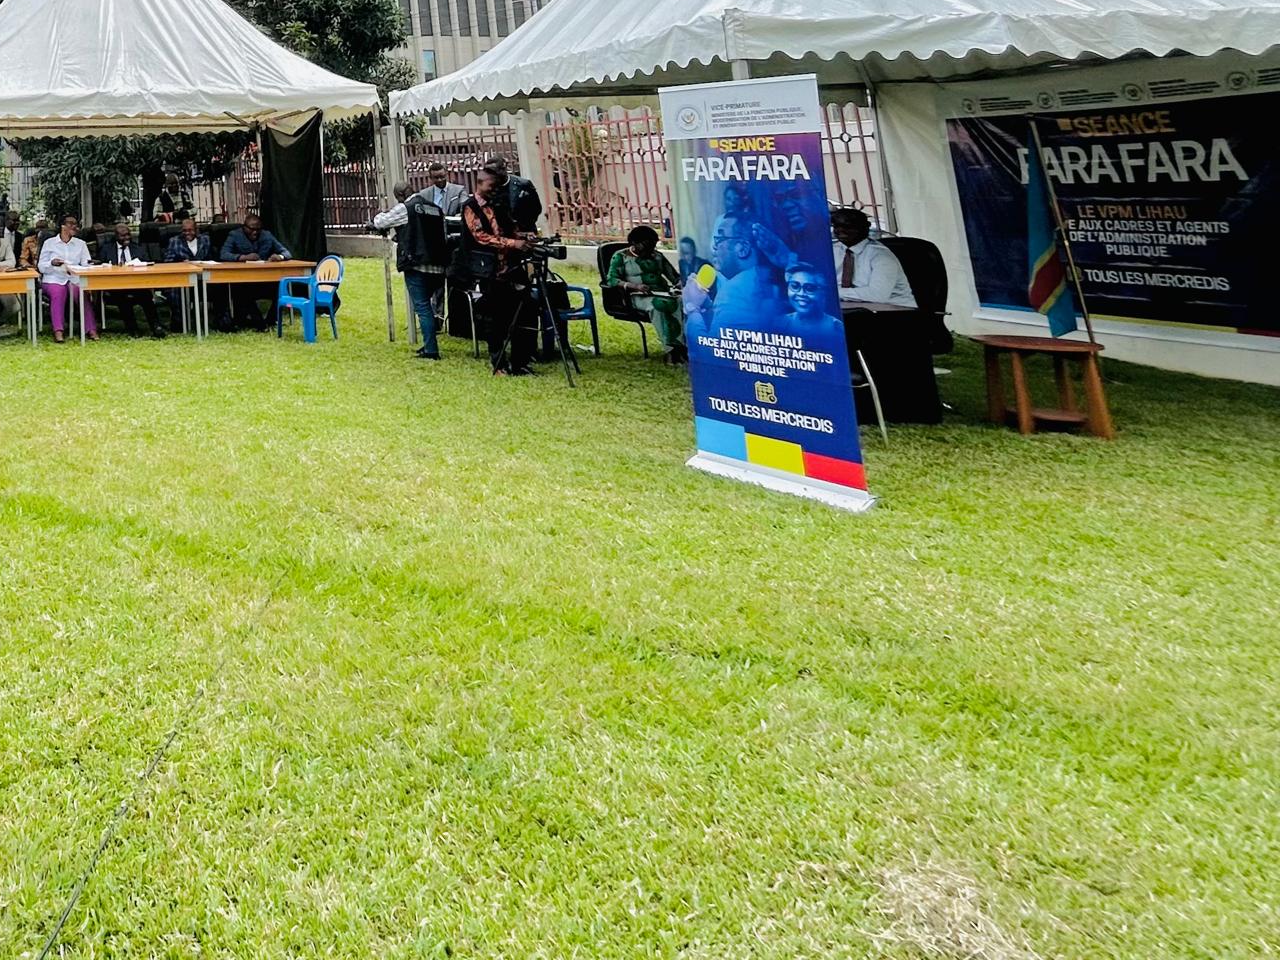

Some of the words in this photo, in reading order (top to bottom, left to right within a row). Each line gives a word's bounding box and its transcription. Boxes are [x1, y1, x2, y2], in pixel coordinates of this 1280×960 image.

[711, 101, 761, 110] VICE-PRIMATURE
[1073, 110, 1176, 137] SEANCE
[719, 136, 776, 153] SEANCE
[681, 156, 742, 181] FARA
[742, 154, 811, 181] FARA
[1118, 138, 1250, 183] FARA
[1077, 205, 1095, 218] LE
[1097, 205, 1133, 218] VPM
[1136, 205, 1187, 219] LIHAU
[1078, 219, 1103, 231] AUX
[1105, 219, 1155, 232] CADRES
[1157, 221, 1172, 232] ET
[1176, 221, 1230, 234] AGENTS
[1070, 231, 1086, 242] DE
[1087, 231, 1207, 246] L'ADMINISTRATION
[1084, 269, 1119, 283] TOUS
[1120, 271, 1144, 285] LES
[1144, 273, 1231, 291] MERCREDIS
[720, 327, 734, 340] LE
[735, 329, 762, 344] VPM
[764, 333, 802, 349] LIHAU
[698, 336, 719, 347] FACE
[720, 339, 739, 350] AUX
[740, 342, 778, 356] CADRES
[778, 347, 791, 357] ET
[792, 349, 833, 364] AGENTS
[714, 348, 725, 358] DE
[726, 349, 816, 372] L'ADMINISTRATION
[709, 396, 738, 414] TOUS
[739, 403, 760, 418] LES
[761, 408, 834, 434] MERCREDIS
